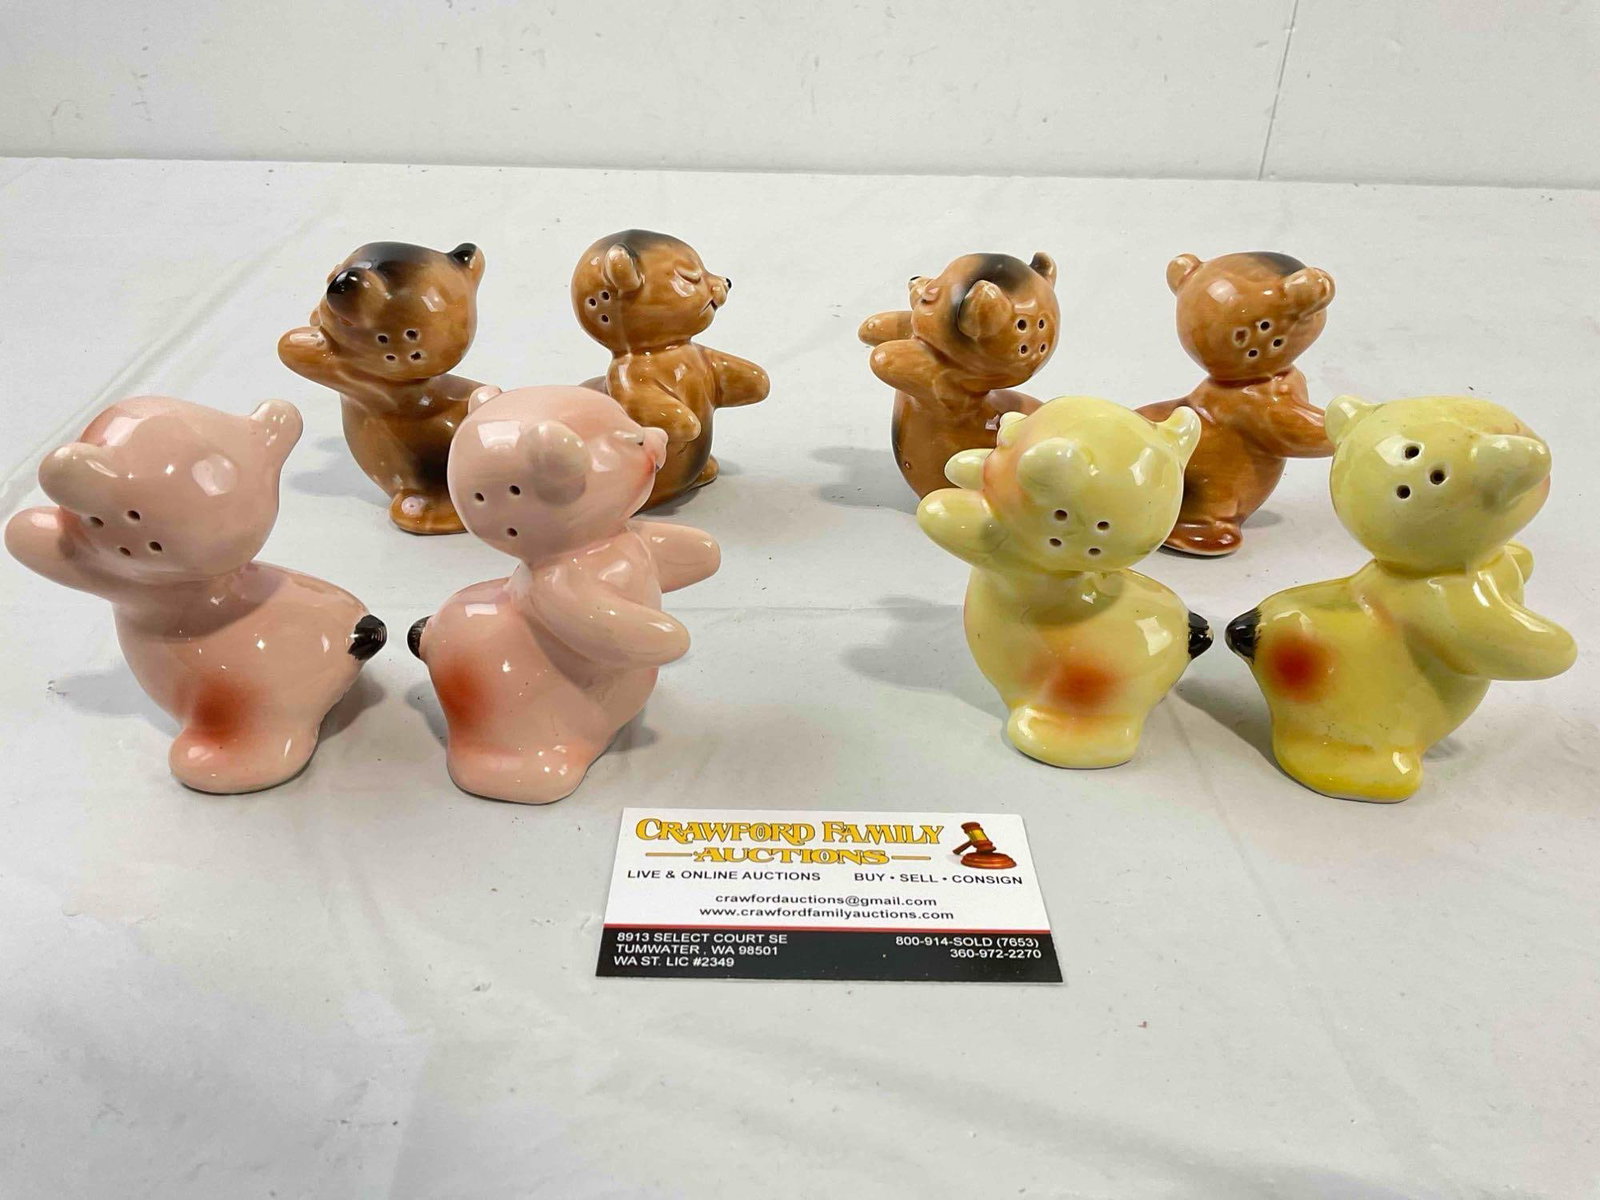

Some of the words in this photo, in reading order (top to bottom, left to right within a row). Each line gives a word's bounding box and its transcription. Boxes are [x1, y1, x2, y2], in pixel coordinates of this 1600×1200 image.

[635, 818, 815, 846] CRAWFORD
[822, 821, 945, 845] FAMILY
[693, 847, 890, 864] AUCTIONS
[627, 870, 661, 879] LIVE
[665, 870, 676, 879] &
[681, 870, 738, 880] ONLINE
[742, 871, 821, 881] AUCTIONS
[854, 873, 886, 882] BUY
[899, 874, 939, 883] SELL
[952, 875, 1023, 885] CONSIGN
[715, 894, 937, 907] crawfordauctions@gmail.com
[699, 907, 954, 919] www.crawfordfamilyauctions.com
[617, 932, 649, 942] 8913
[653, 932, 710, 943] SELECT
[713, 933, 765, 944] COURT
[768, 934, 788, 944] SE
[895, 936, 993, 947] 800-914-SOLD
[996, 937, 1039, 948] (7653)
[615, 943, 700, 955] TUMWATER
[711, 945, 735, 955] WA
[738, 945, 778, 955] 98501
[950, 949, 1042, 959] 360-972-2270
[613, 956, 637, 966] WA
[640, 957, 662, 967] ST.
[666, 957, 689, 967] LIC
[693, 957, 735, 967] #2349
